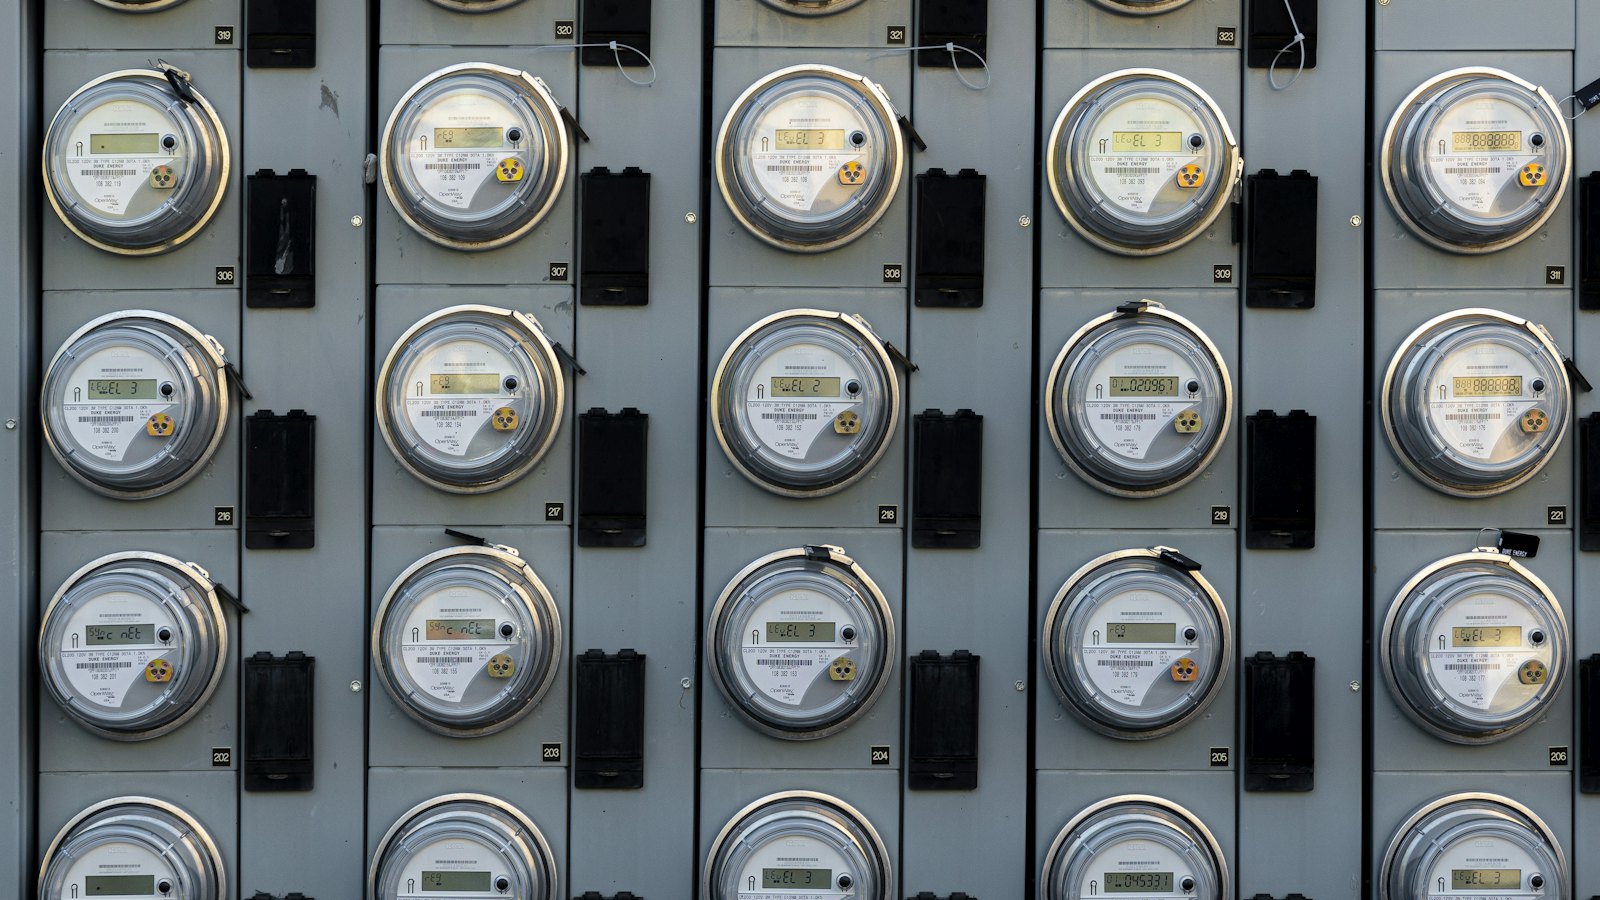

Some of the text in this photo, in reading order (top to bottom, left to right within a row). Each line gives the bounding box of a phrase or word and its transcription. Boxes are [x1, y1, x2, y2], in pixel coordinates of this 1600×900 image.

[557, 25, 572, 35] 320
[217, 31, 231, 40] 319
[890, 31, 903, 40] 321
[1218, 32, 1234, 41] 323
[818, 132, 824, 144] 3
[1155, 134, 1162, 147] 3
[217, 271, 233, 281] 306
[551, 267, 566, 277] 307
[885, 269, 900, 278] 308
[1215, 269, 1231, 279] 309
[1550, 270, 1561, 280] 311
[131, 382, 137, 394] 3
[812, 380, 820, 392] 2
[1130, 379, 1173, 392] 020967
[217, 511, 231, 521] 216
[548, 507, 561, 516] 217
[881, 510, 895, 519] 218
[1214, 511, 1228, 520] 219
[1551, 511, 1564, 520] 221
[809, 624, 815, 637] 3
[1495, 629, 1501, 642] 3
[214, 753, 229, 762] 202
[544, 748, 560, 757] 203
[873, 751, 888, 760] 204
[1212, 753, 1227, 762] 205
[1551, 752, 1566, 761] 206
[805, 871, 812, 883] 3
[1124, 875, 1168, 887] 045331
[1494, 872, 1501, 884] 3
